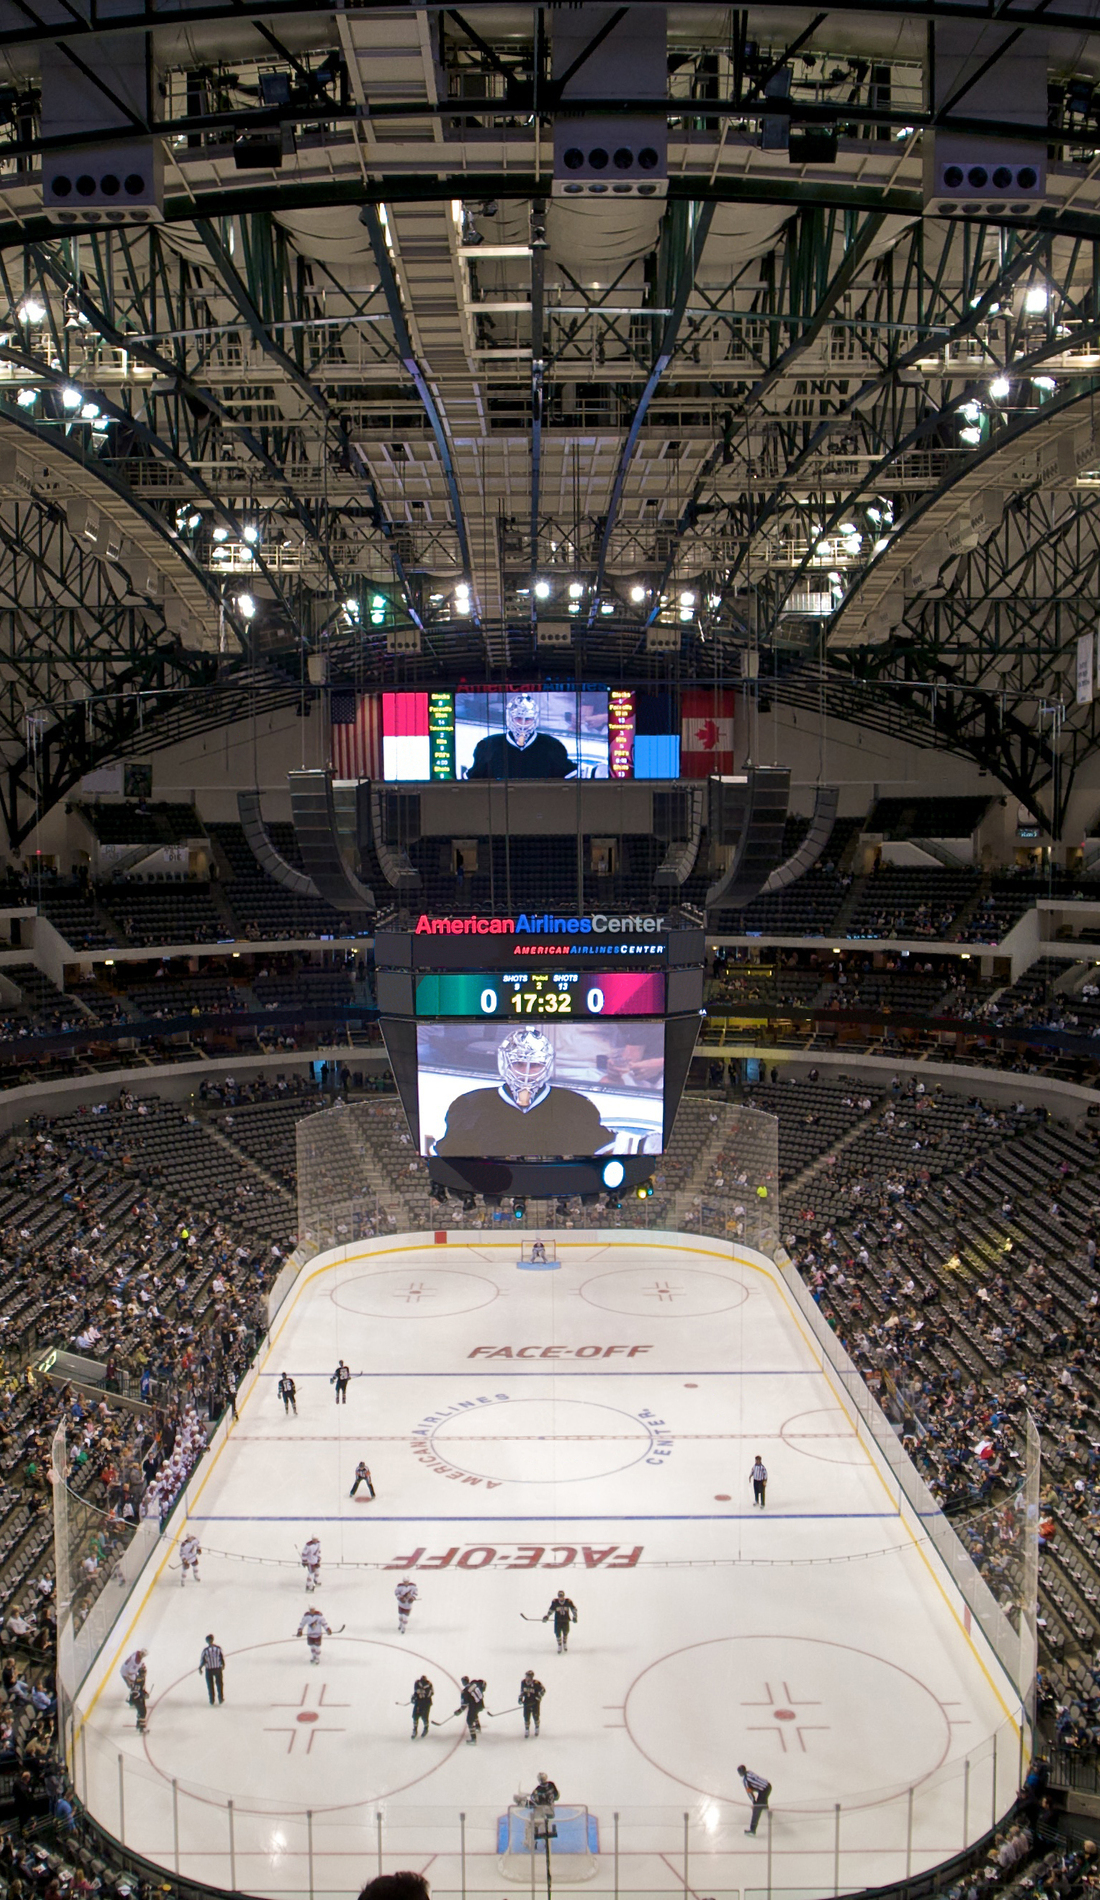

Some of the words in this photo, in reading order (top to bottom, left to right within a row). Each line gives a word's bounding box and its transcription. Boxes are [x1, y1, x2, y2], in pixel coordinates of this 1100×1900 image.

[503, 974, 528, 982] SHOTS
[514, 982, 520, 990] 9
[536, 982, 542, 990] 2
[553, 974, 579, 982] SHOTS
[558, 982, 569, 990] 13
[480, 989, 498, 1013] 0
[511, 993, 571, 1013] 17:32
[587, 988, 605, 1013] 0
[467, 1345, 654, 1359] FACE-OFF
[411, 1393, 509, 1436] AIRLINES
[410, 1441, 503, 1489] AMERICAN
[382, 1546, 644, 1571] FACE-OFF
[470, 1687, 483, 1703] 10
